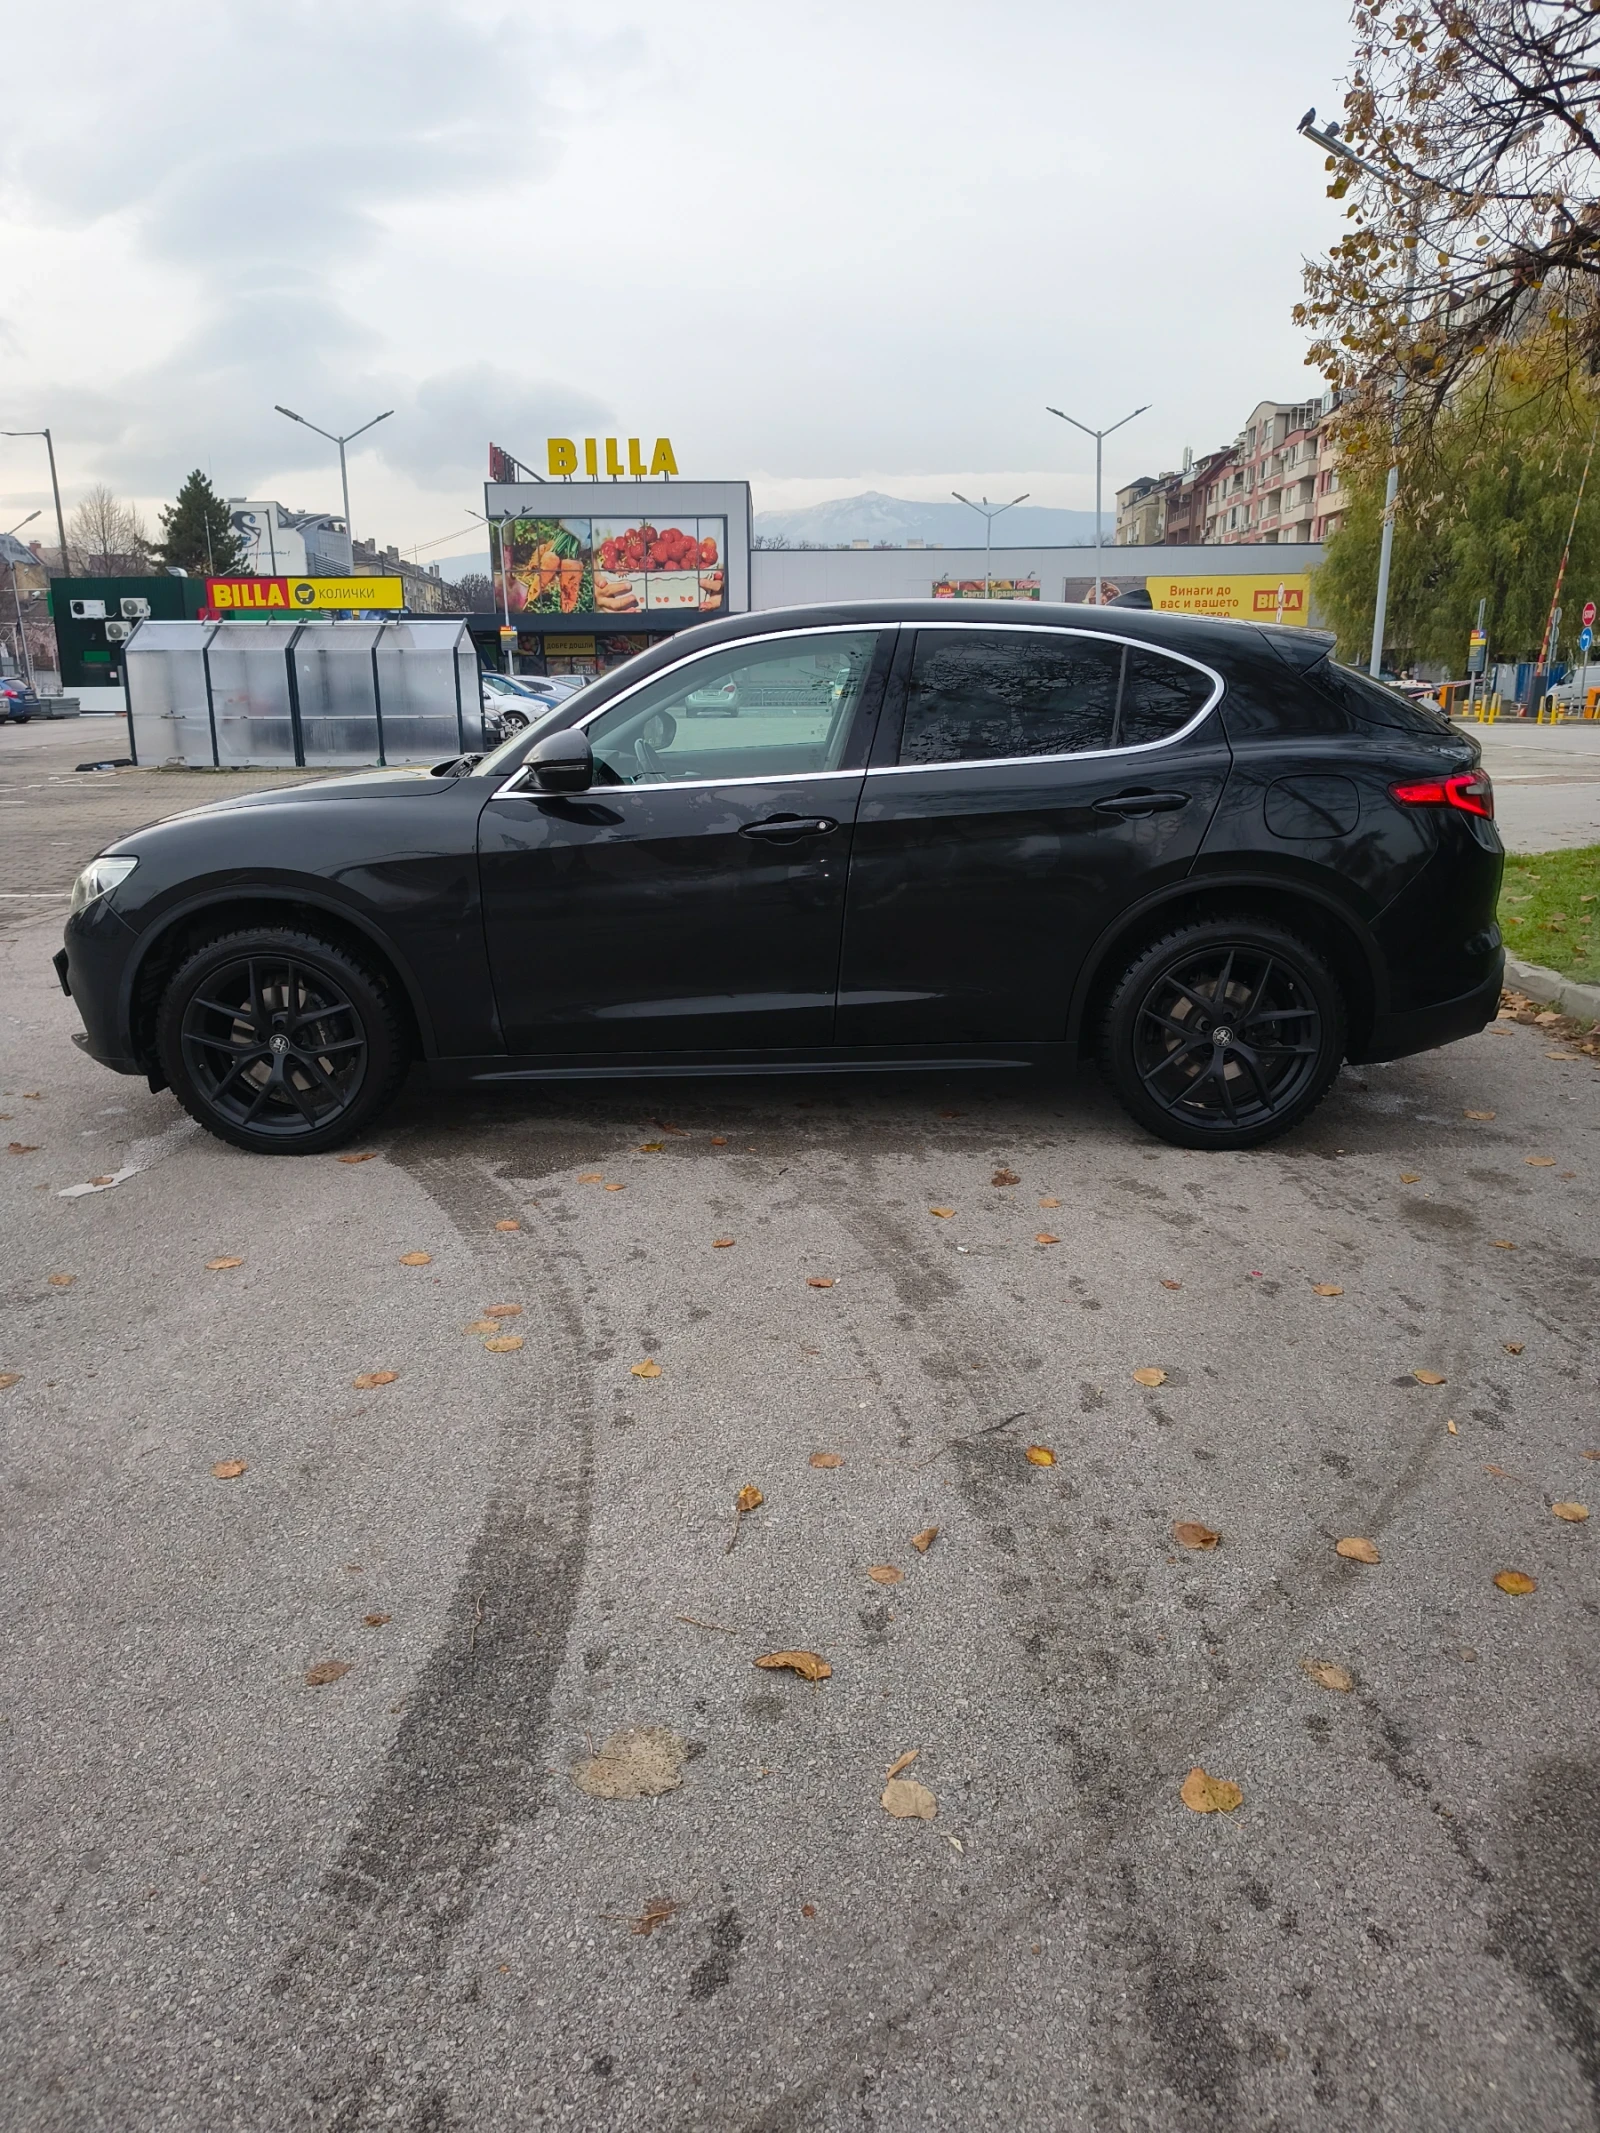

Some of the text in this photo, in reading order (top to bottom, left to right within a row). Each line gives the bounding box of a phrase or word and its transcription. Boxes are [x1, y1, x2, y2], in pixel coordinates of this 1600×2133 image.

[547, 438, 679, 475] BILLA
[212, 583, 285, 608] BILLA
[318, 588, 375, 599] КОЛИЧКИ
[1169, 585, 1231, 596] Винаги до
[1160, 599, 1239, 608] вас и вашето
[1256, 593, 1300, 608] BILLA
[1584, 610, 1594, 619] STOP
[568, 642, 594, 650] ДОШЛИ
